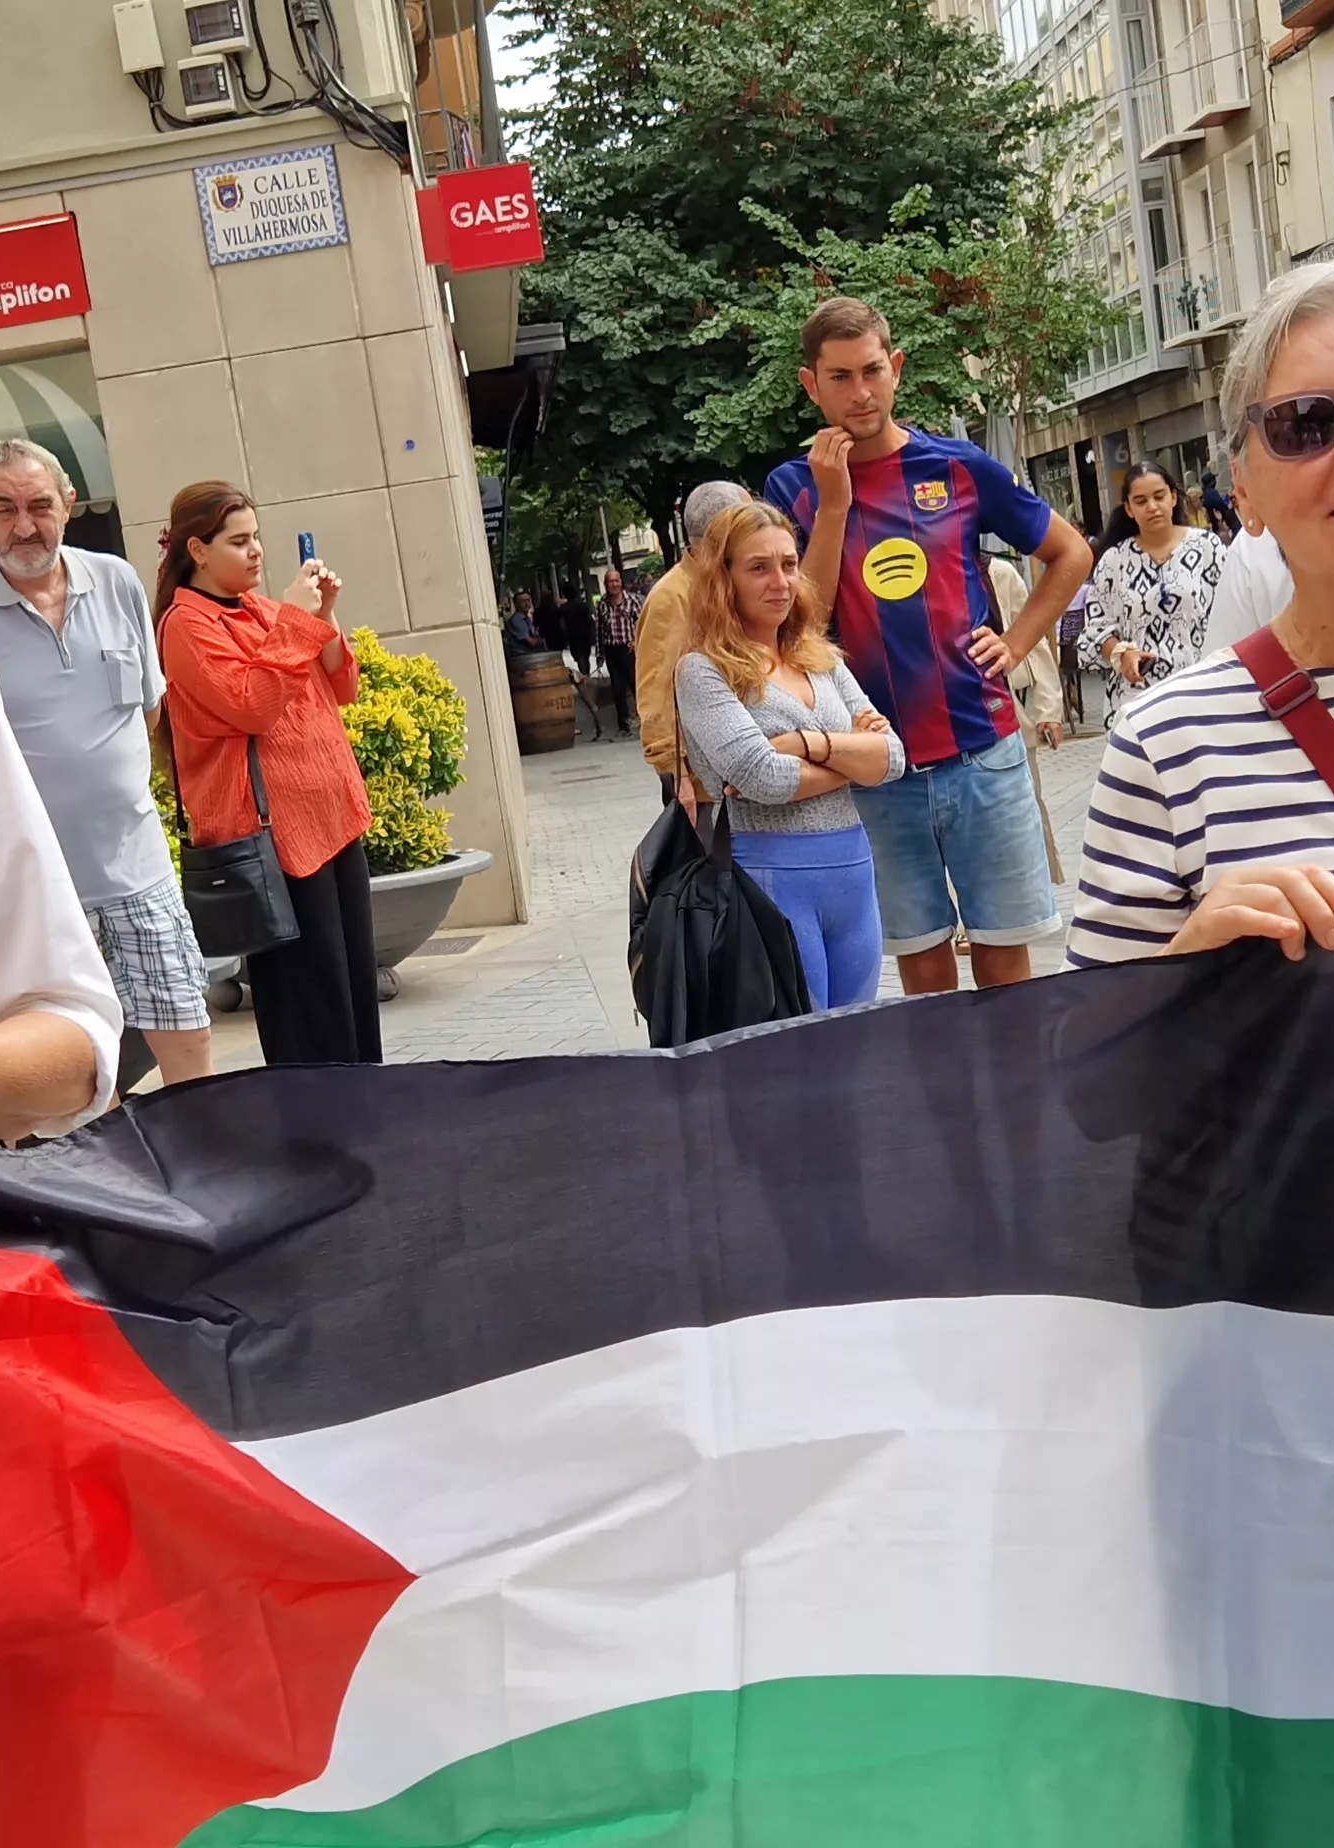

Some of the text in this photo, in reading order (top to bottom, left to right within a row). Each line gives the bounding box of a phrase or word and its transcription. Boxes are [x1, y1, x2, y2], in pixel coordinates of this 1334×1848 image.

[253, 167, 320, 195] CALLE
[250, 188, 329, 220] DUQUESA DE
[450, 193, 530, 228] GAES
[222, 213, 328, 247] VILLAHERMOSA
